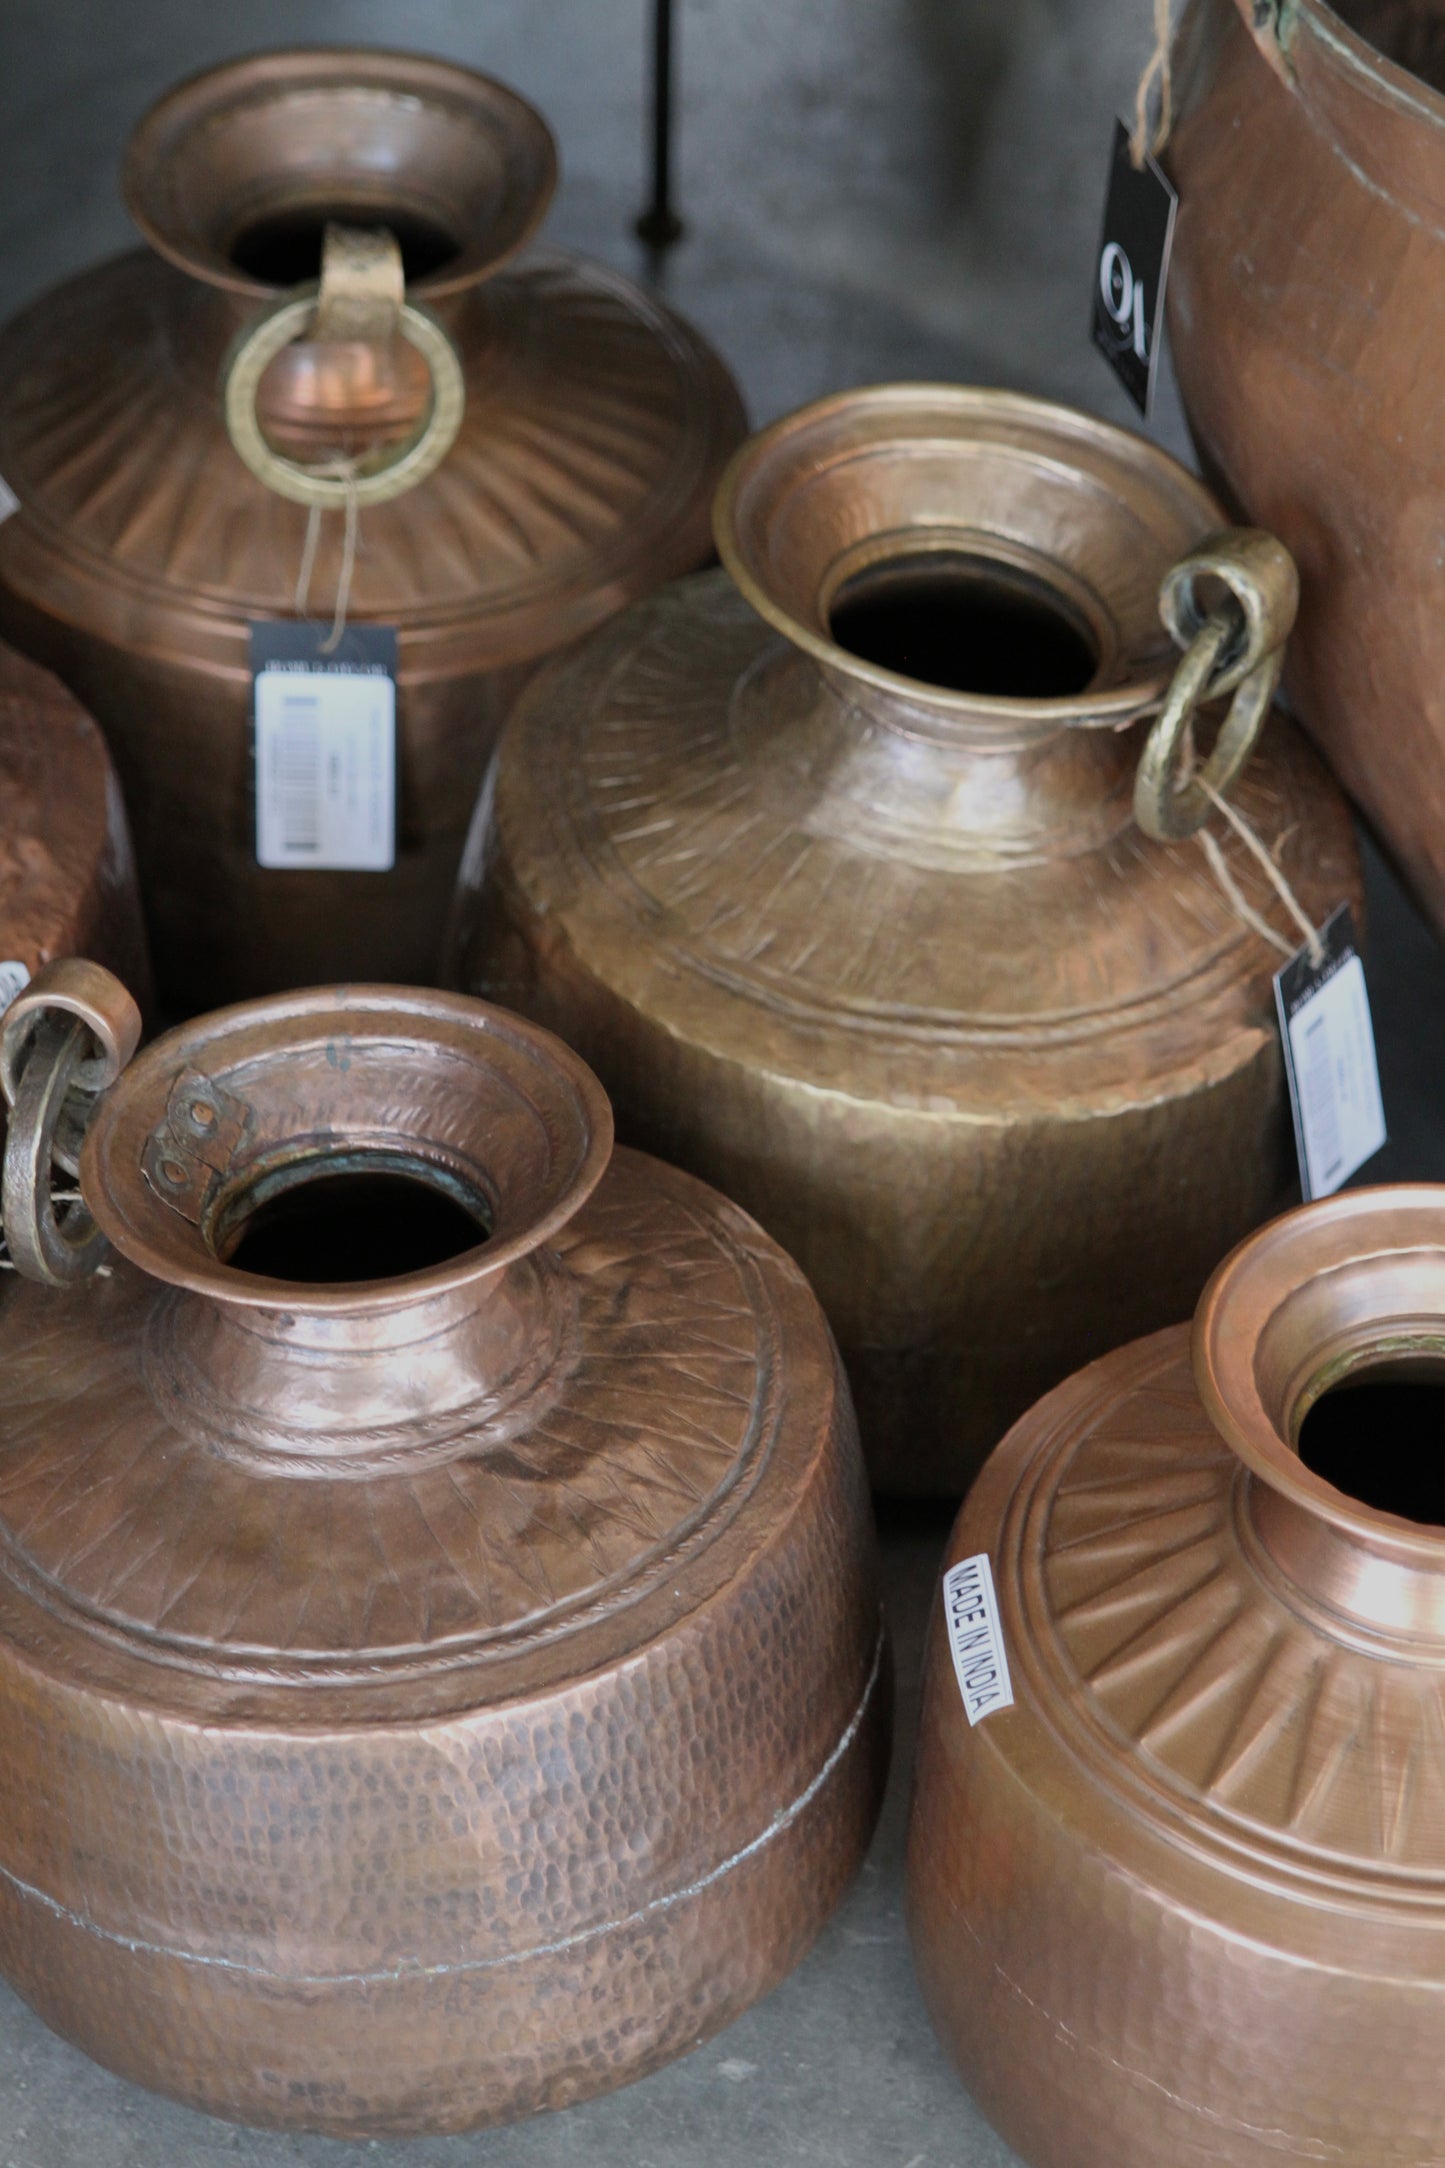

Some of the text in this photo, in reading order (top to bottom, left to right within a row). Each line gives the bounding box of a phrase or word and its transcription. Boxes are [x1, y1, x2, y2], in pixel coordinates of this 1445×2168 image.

[950, 1564, 1000, 1714] MADE IN INDIA
